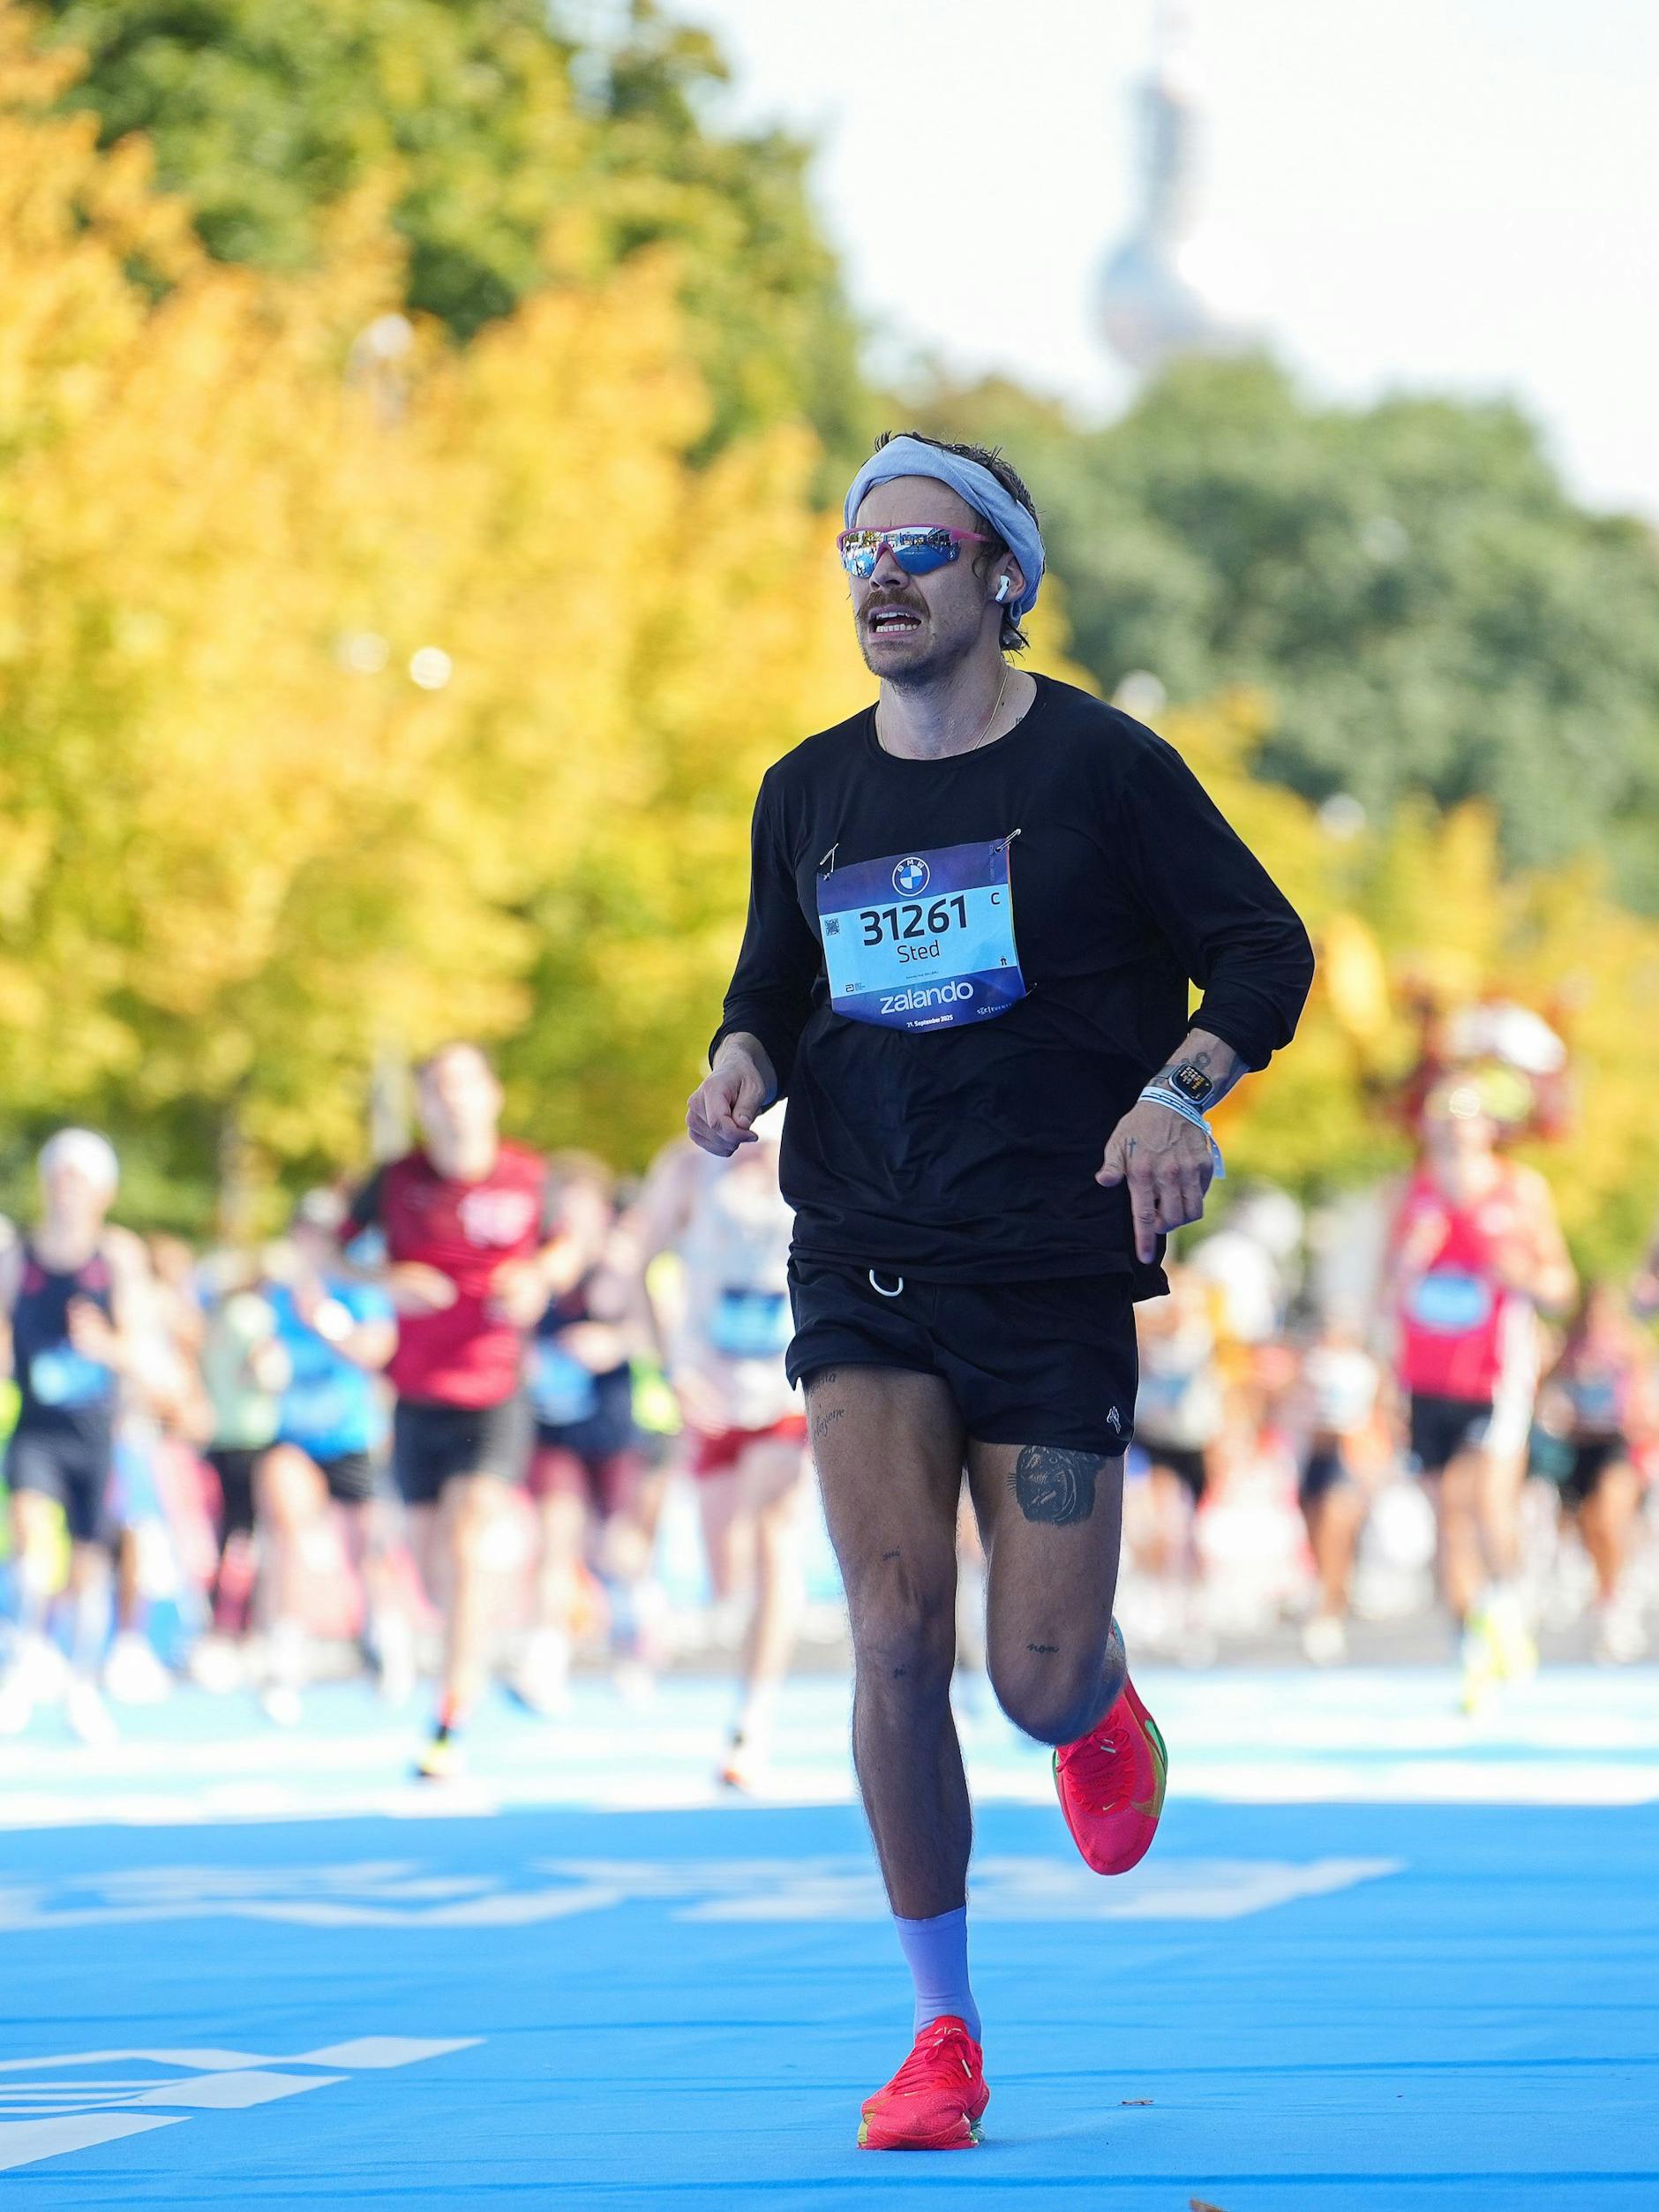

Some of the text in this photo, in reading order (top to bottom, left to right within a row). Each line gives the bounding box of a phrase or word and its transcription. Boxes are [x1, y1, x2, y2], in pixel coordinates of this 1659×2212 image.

[897, 859, 925, 873] BMW
[990, 892, 1001, 906] C
[860, 894, 967, 947] 31261
[897, 939, 941, 964] Sted
[879, 980, 974, 1015] zalando
[914, 1016, 942, 1027] September
